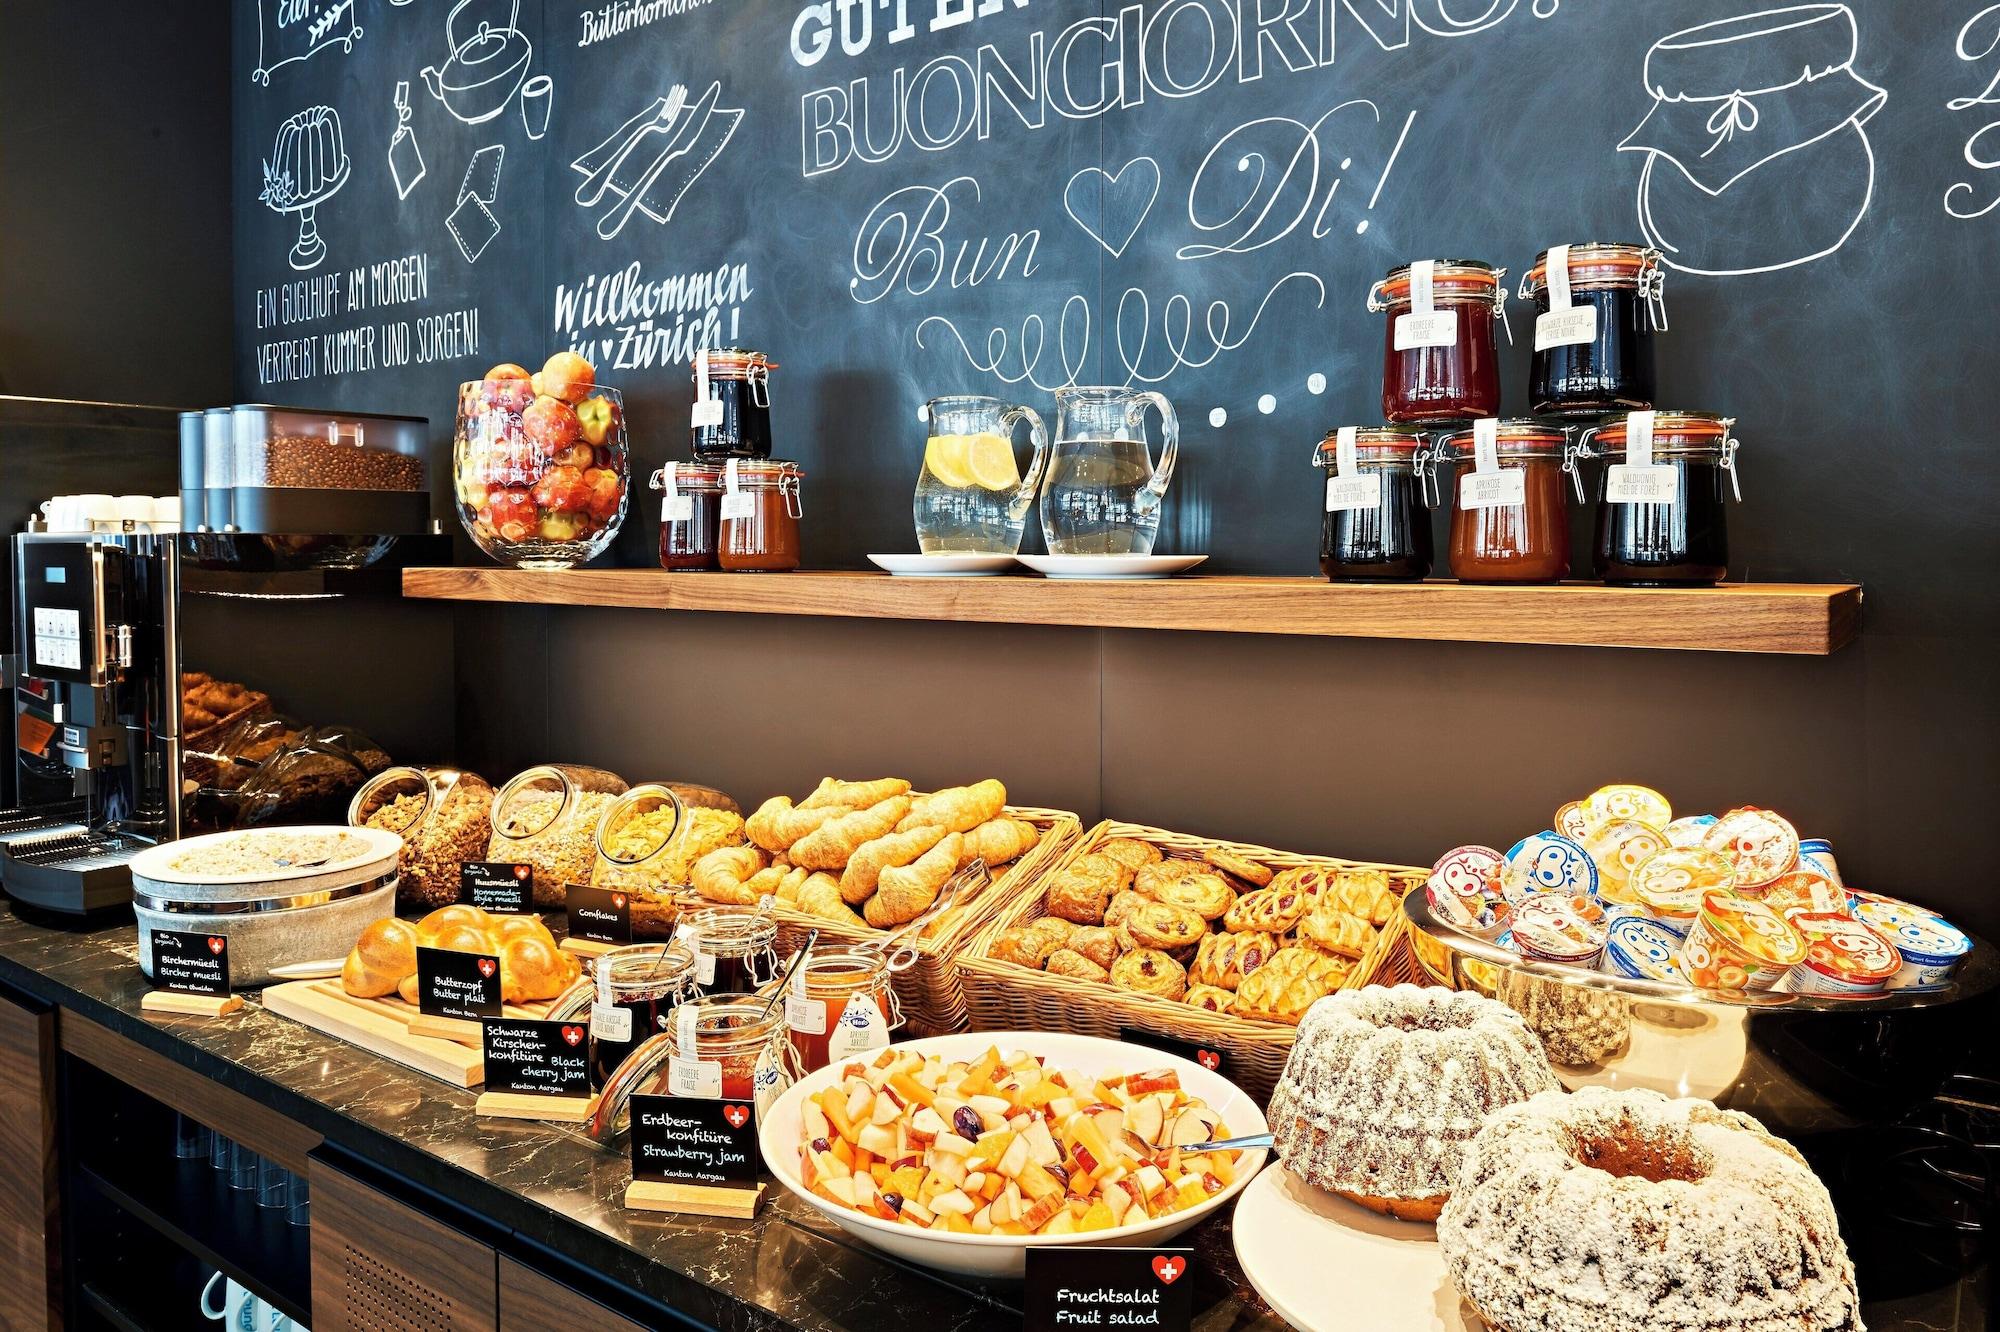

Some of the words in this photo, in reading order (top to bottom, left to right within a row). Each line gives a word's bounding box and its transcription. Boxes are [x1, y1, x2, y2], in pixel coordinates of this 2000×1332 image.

[850, 176, 1041, 304] Bun
[1176, 99, 1417, 260] Di!
[281, 272, 341, 325] GUGLHUPF
[348, 266, 366, 312] AM
[371, 253, 428, 308] MORGEN
[554, 260, 754, 334] Willkommen
[323, 325, 376, 376] KUMMER
[382, 321, 410, 368] UND
[416, 307, 479, 364] SORGEN!
[578, 908, 618, 922] Cornflakes
[161, 955, 219, 969] Birchermüesli
[160, 967, 190, 978] Bircher
[193, 972, 222, 981] muesli
[435, 976, 482, 995] Butterzopf
[433, 988, 461, 1000] Butter
[464, 992, 486, 1006] plait
[443, 1007, 463, 1016] Kanton
[486, 1026, 538, 1038] Schwarze
[492, 1038, 546, 1050] Kirschen-
[488, 1049, 544, 1063] konfitüre
[551, 1056, 585, 1067] Black
[521, 1066, 558, 1082] cherry
[560, 1067, 585, 1082] jam
[511, 1082, 536, 1090] Kanton
[539, 1084, 563, 1093] Aargau
[641, 1113, 702, 1128] Erdbeer-
[667, 1128, 732, 1144] konfitüre
[643, 1144, 713, 1166] Strawberry
[715, 1148, 744, 1166] jam
[664, 1169, 693, 1178] Kanton
[696, 1172, 725, 1182] Aargau
[1057, 1288, 1159, 1303] Fruchtsalat
[1056, 1310, 1101, 1324] Fruit
[1109, 1309, 1159, 1325] salad
